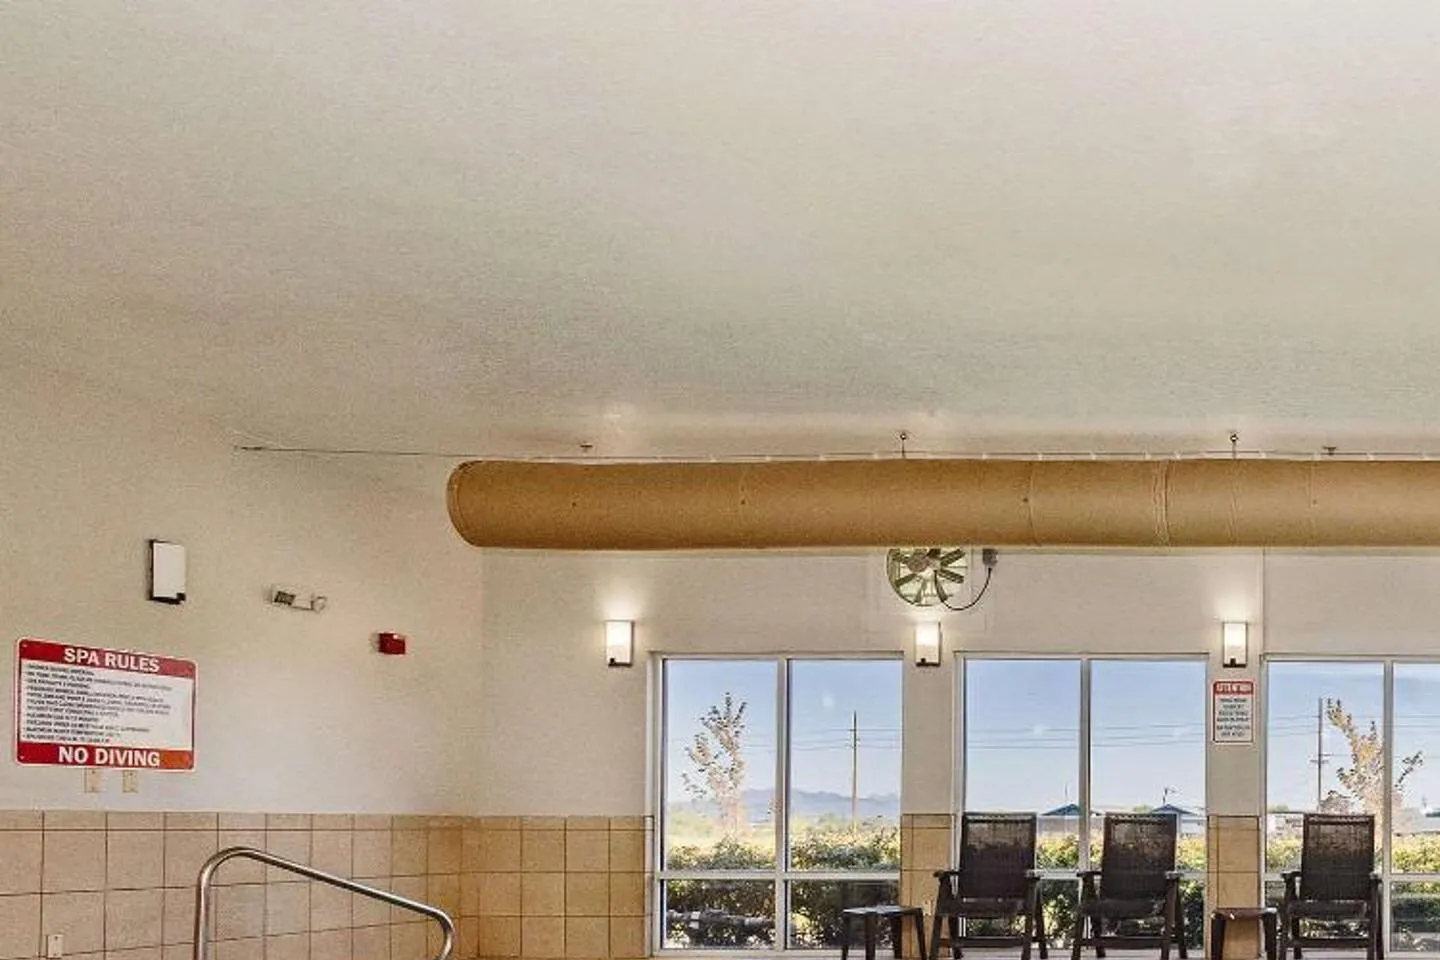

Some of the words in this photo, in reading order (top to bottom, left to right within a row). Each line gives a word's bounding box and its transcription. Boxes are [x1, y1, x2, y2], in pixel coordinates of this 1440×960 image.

[64, 648, 99, 666] SPA
[105, 652, 160, 673] RULES
[58, 746, 89, 764] NO
[95, 748, 161, 767] DIVING
